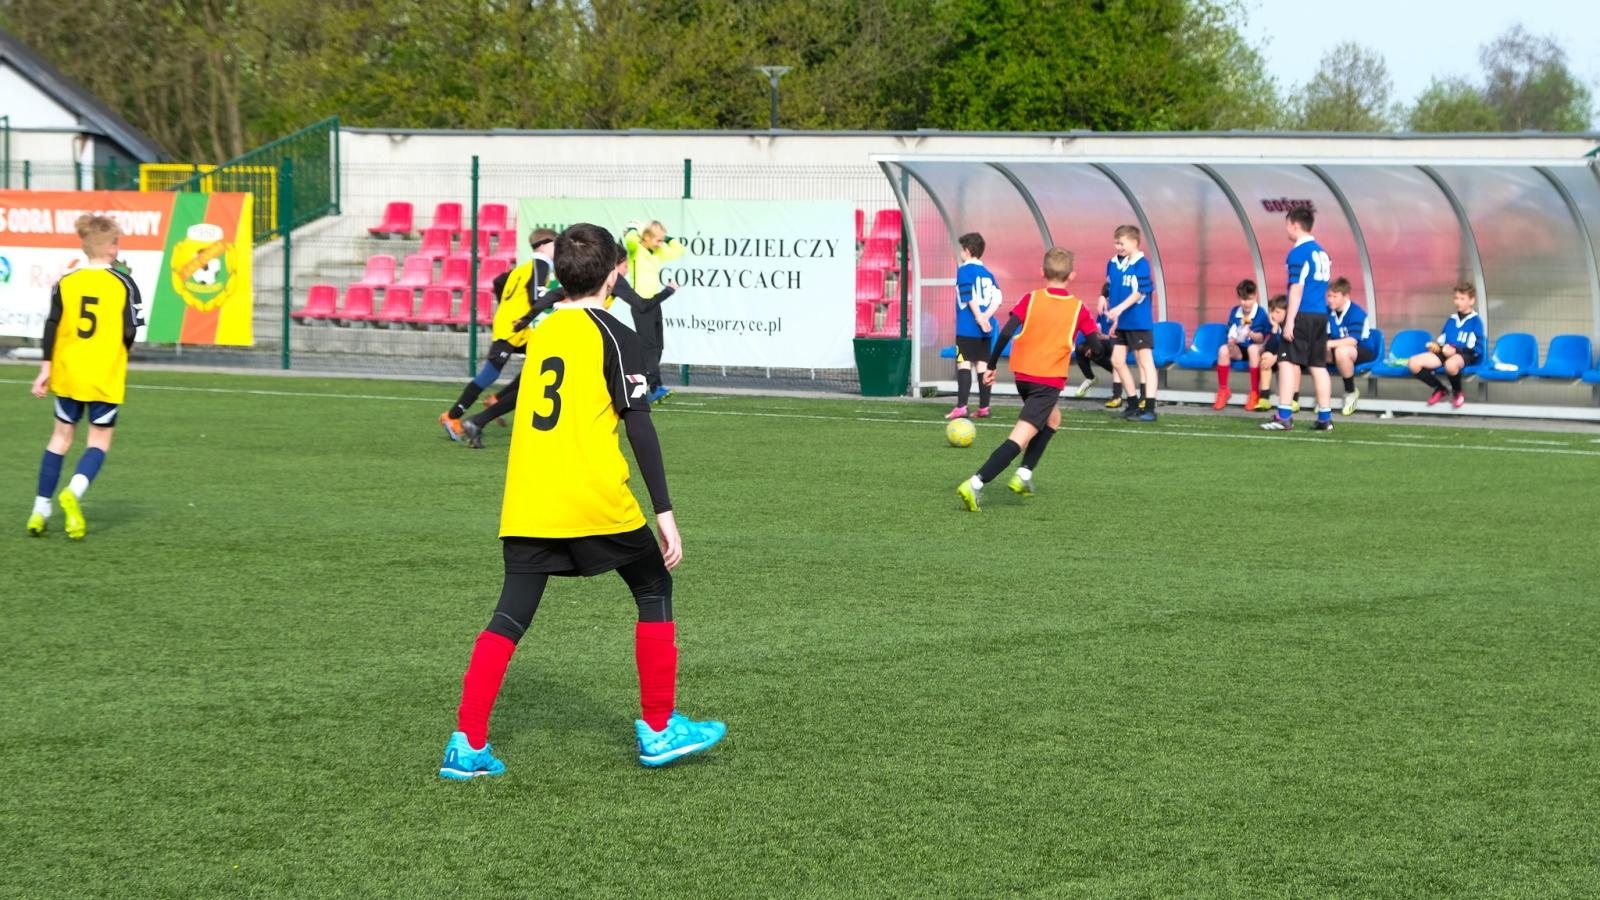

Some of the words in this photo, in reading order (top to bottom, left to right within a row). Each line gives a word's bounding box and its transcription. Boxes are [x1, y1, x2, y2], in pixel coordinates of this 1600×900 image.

[8, 208, 54, 233] ODRA
[679, 231, 840, 258] PÓŁDZIELCZY
[659, 268, 802, 290] GORZYCACH
[77, 295, 100, 340] 5
[663, 314, 782, 337] ww.bsgorzyce.pl
[531, 356, 565, 432] 3
